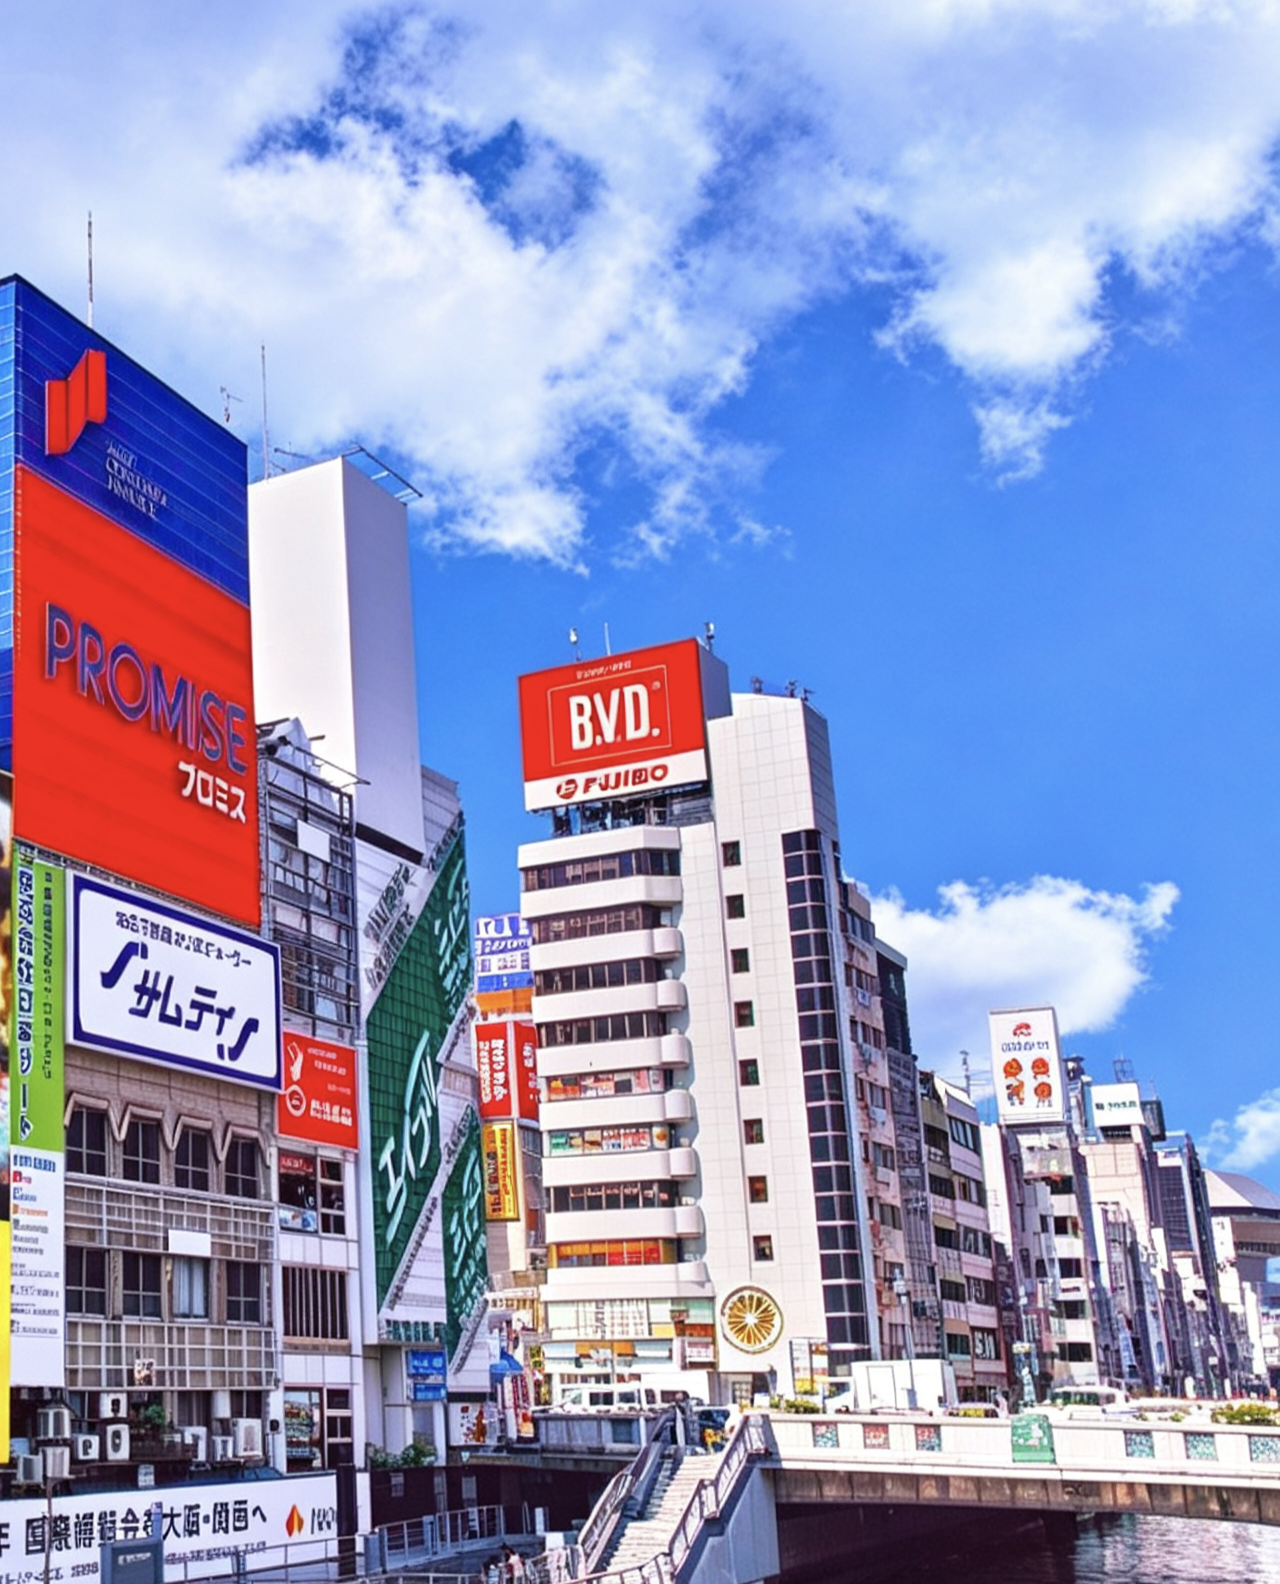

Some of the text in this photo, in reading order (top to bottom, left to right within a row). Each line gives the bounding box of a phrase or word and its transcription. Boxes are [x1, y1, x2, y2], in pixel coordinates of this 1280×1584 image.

[44, 601, 248, 776] PROMISE
[569, 683, 661, 750] B.V.D.
[583, 764, 668, 795] FUJIBO
[128, 969, 236, 1036] サムティ
